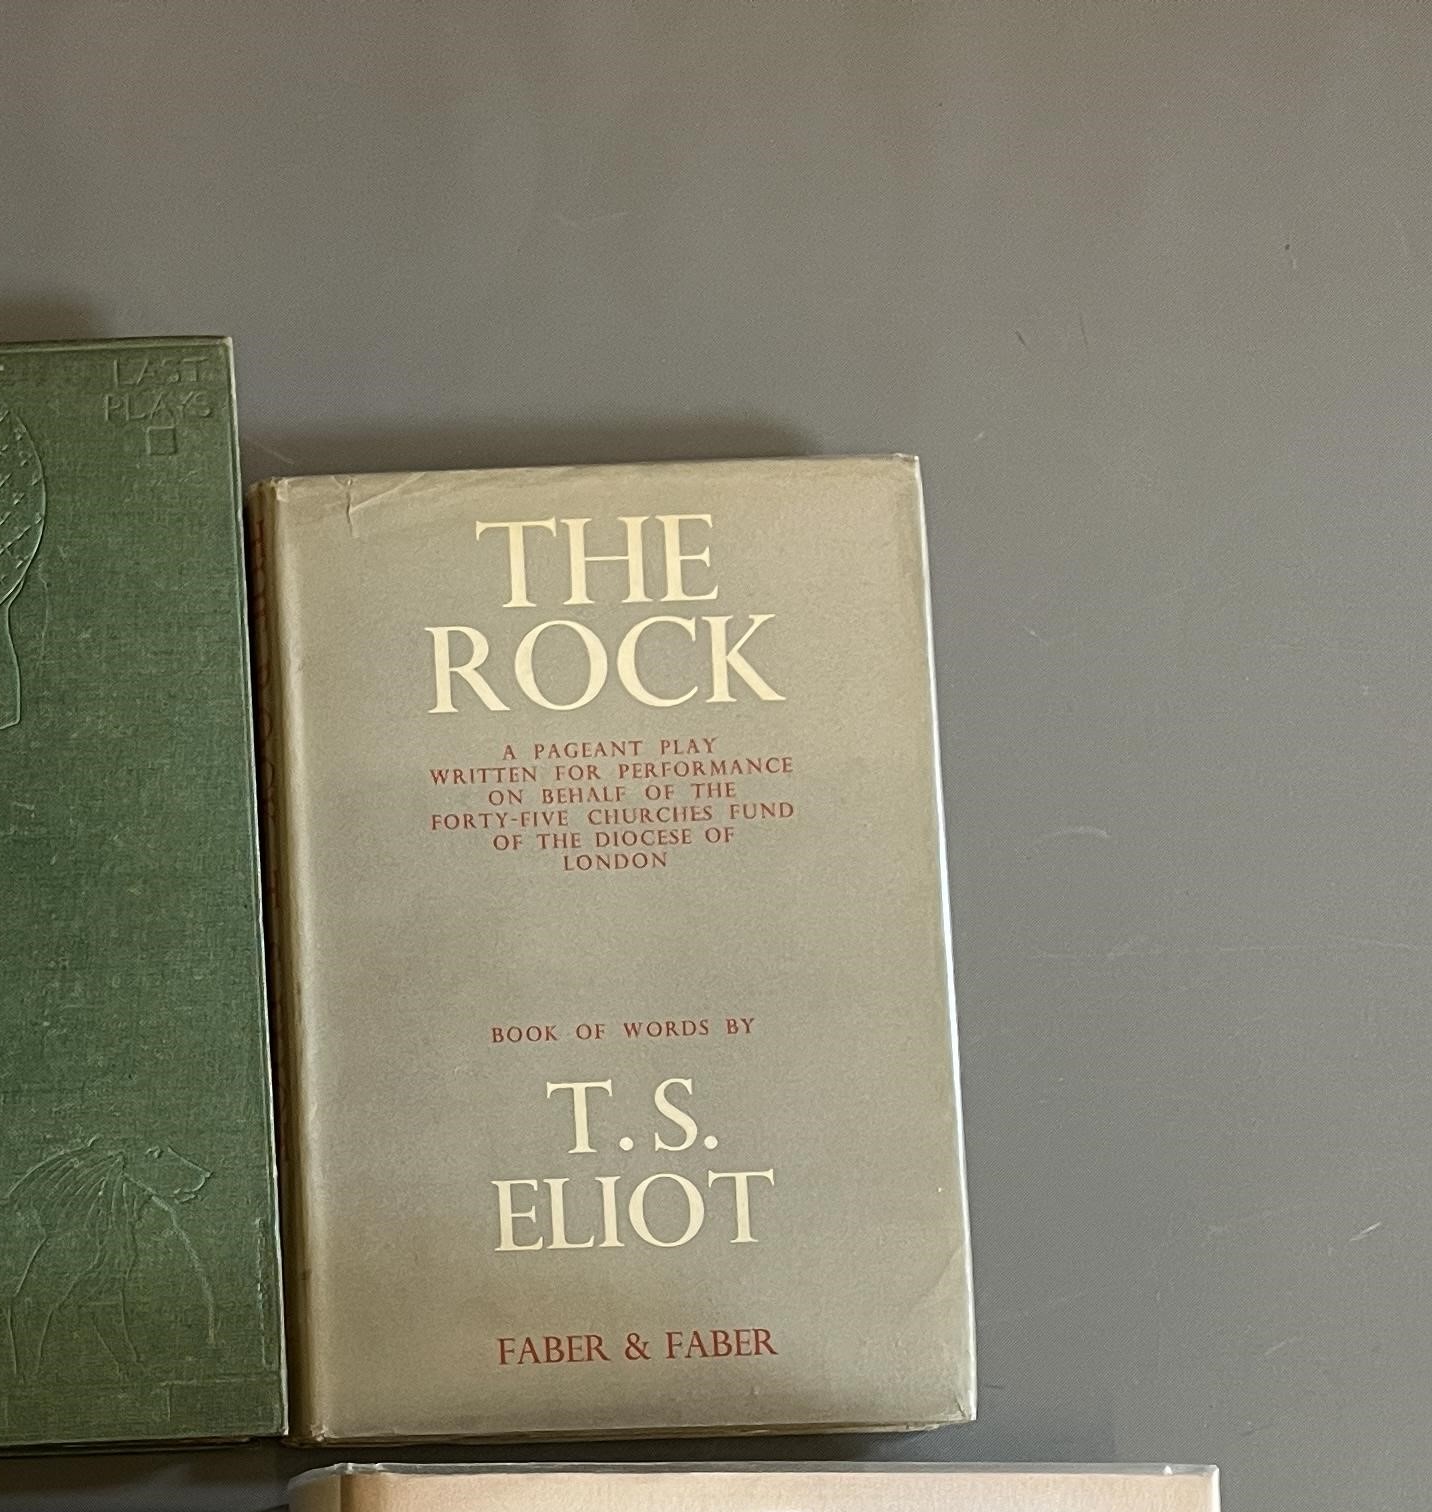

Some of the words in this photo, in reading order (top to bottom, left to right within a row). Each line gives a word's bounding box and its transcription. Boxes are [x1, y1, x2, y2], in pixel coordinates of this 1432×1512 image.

[475, 514, 719, 608] THE
[424, 613, 786, 714] ROCK
[502, 744, 518, 761] A
[534, 739, 643, 760] PAGEANT
[660, 737, 719, 755] PLAY
[429, 765, 537, 786] WRITTEN
[555, 763, 600, 782] FOR
[618, 756, 794, 779] PERFORMANCE
[488, 788, 523, 806] ON
[541, 785, 627, 804] BEHALF
[644, 783, 676, 800] OF
[691, 781, 737, 799] THE
[431, 808, 568, 830] FORTY-FIVE
[587, 804, 713, 825] CHURCHES
[729, 801, 794, 820] FUND
[493, 833, 523, 851] OF
[537, 831, 582, 850] THE
[595, 828, 691, 848] DIOCESE
[704, 826, 735, 843] OF
[563, 850, 668, 872] LONDON
[491, 1025, 559, 1044] BOOK
[576, 1023, 606, 1040] OF
[623, 1019, 709, 1039] WORDS
[725, 1017, 755, 1036] BY
[546, 1080, 634, 1154] T.
[653, 1077, 718, 1152] S.
[491, 1168, 775, 1252] ELIOT
[498, 1334, 610, 1366] FABER
[624, 1332, 650, 1361] &
[665, 1328, 778, 1359] FABER
